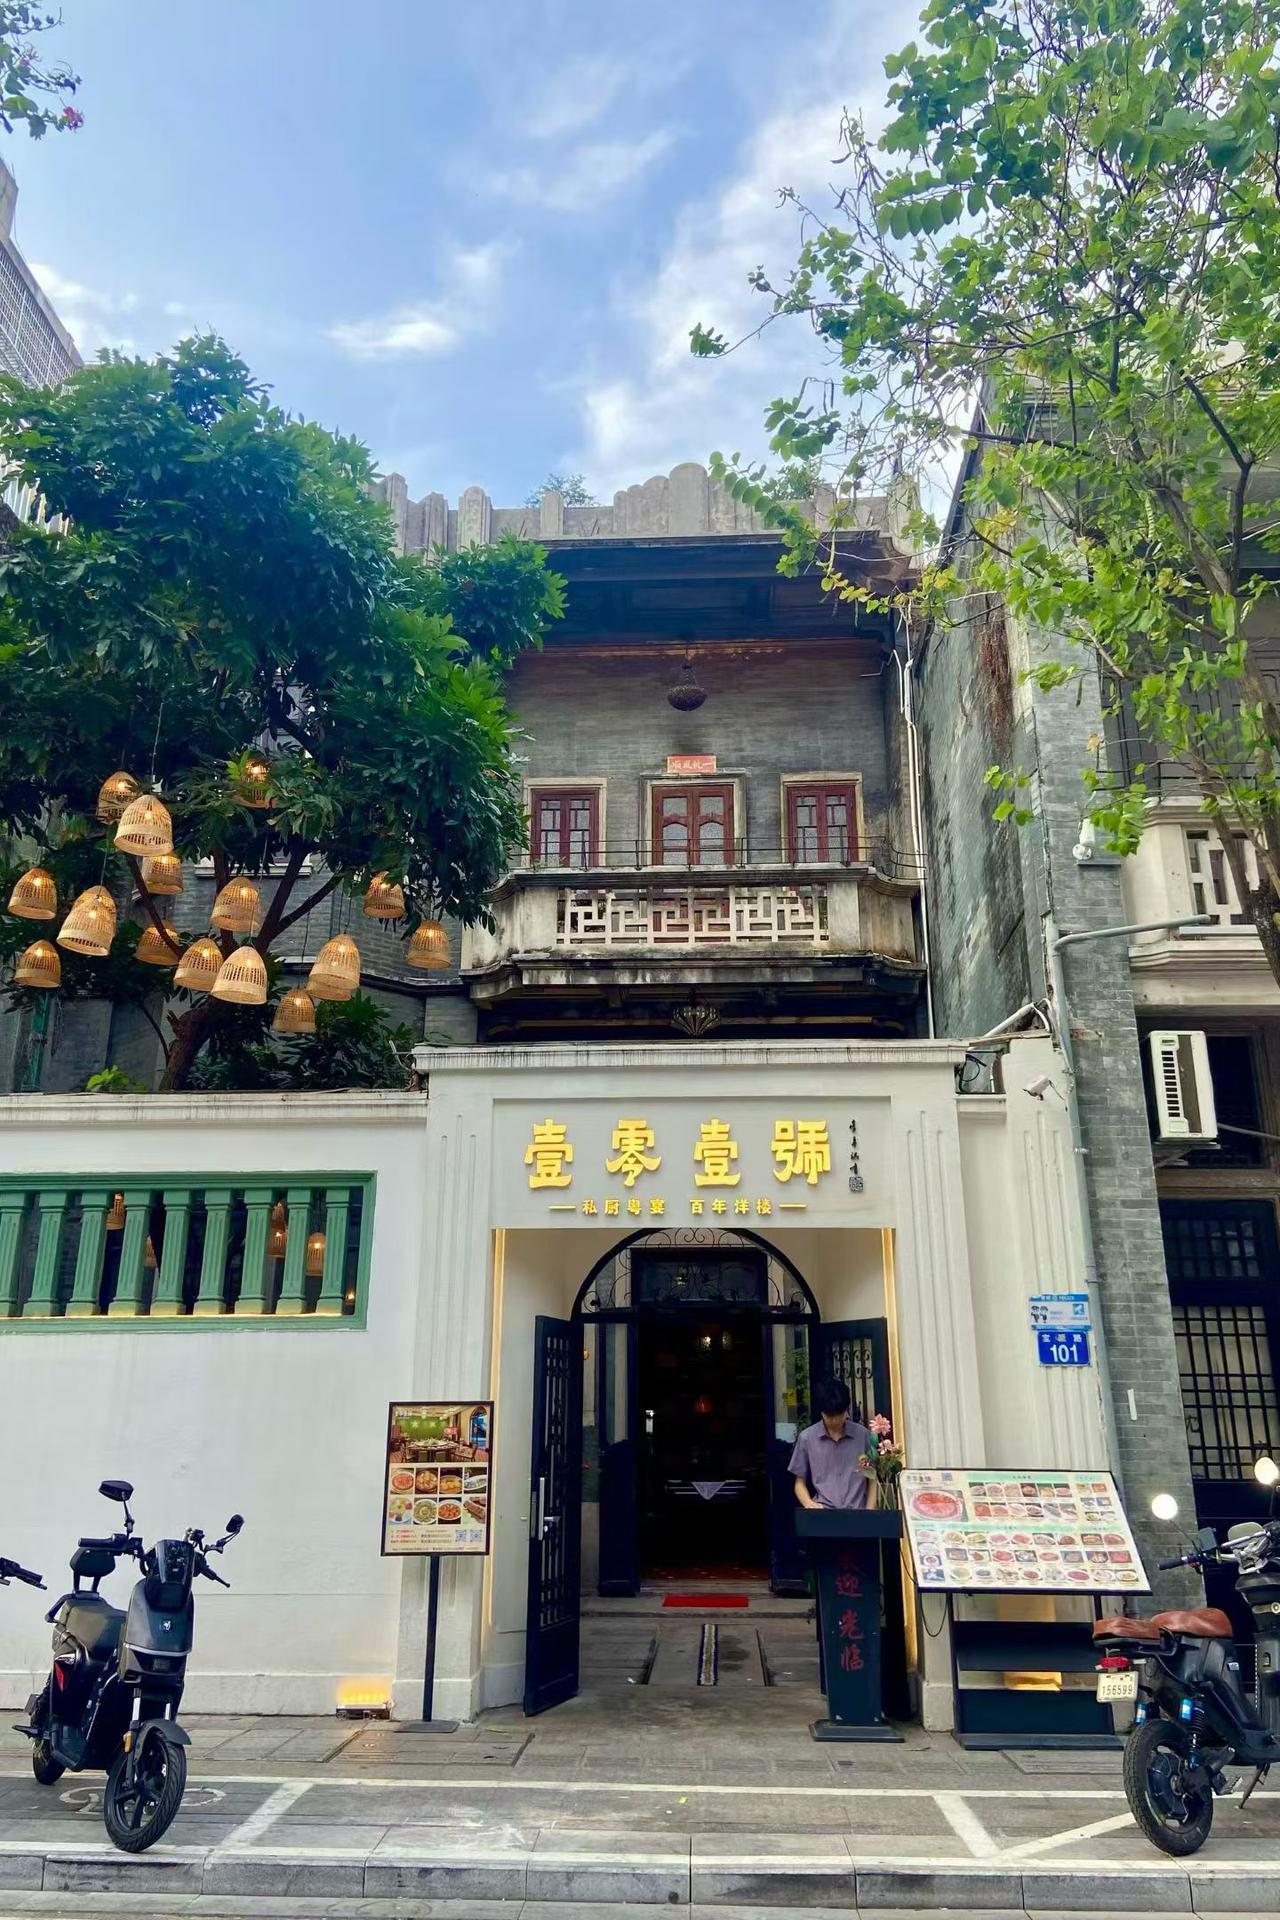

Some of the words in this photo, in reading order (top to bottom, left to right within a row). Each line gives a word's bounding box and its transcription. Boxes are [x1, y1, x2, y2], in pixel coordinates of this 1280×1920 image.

[524, 1118, 831, 1189] 壹零壹號
[582, 1198, 666, 1216] 私厨粤宴
[690, 1197, 773, 1215] 百年洋楼
[1050, 1344, 1079, 1363] 101
